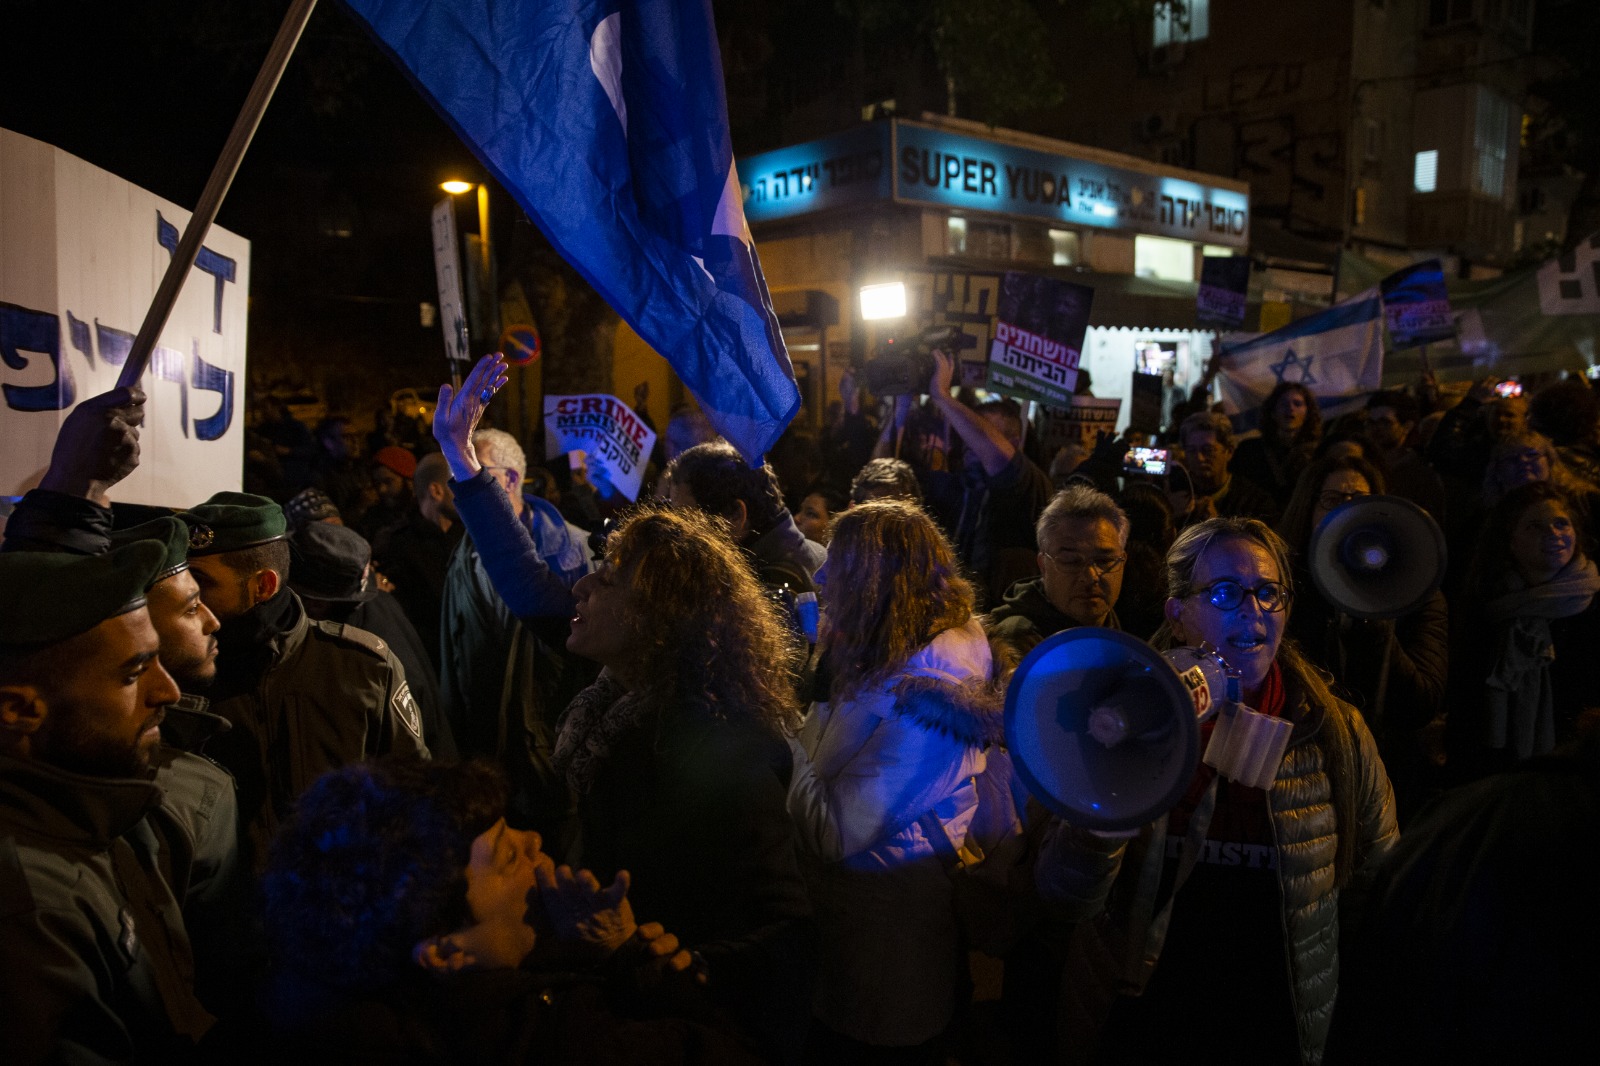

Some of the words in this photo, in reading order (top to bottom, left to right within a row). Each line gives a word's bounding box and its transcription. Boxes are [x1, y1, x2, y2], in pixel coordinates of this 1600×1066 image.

[776, 162, 818, 198] יודה
[902, 144, 997, 197] SUPER
[1005, 164, 1071, 207] YUDA
[1161, 194, 1200, 229] יודה
[1205, 202, 1244, 236] סופר
[997, 322, 1080, 370] מושחתים
[1003, 344, 1066, 384] הביתה!
[557, 397, 648, 449] CRIME
[557, 413, 640, 463] MINISTER
